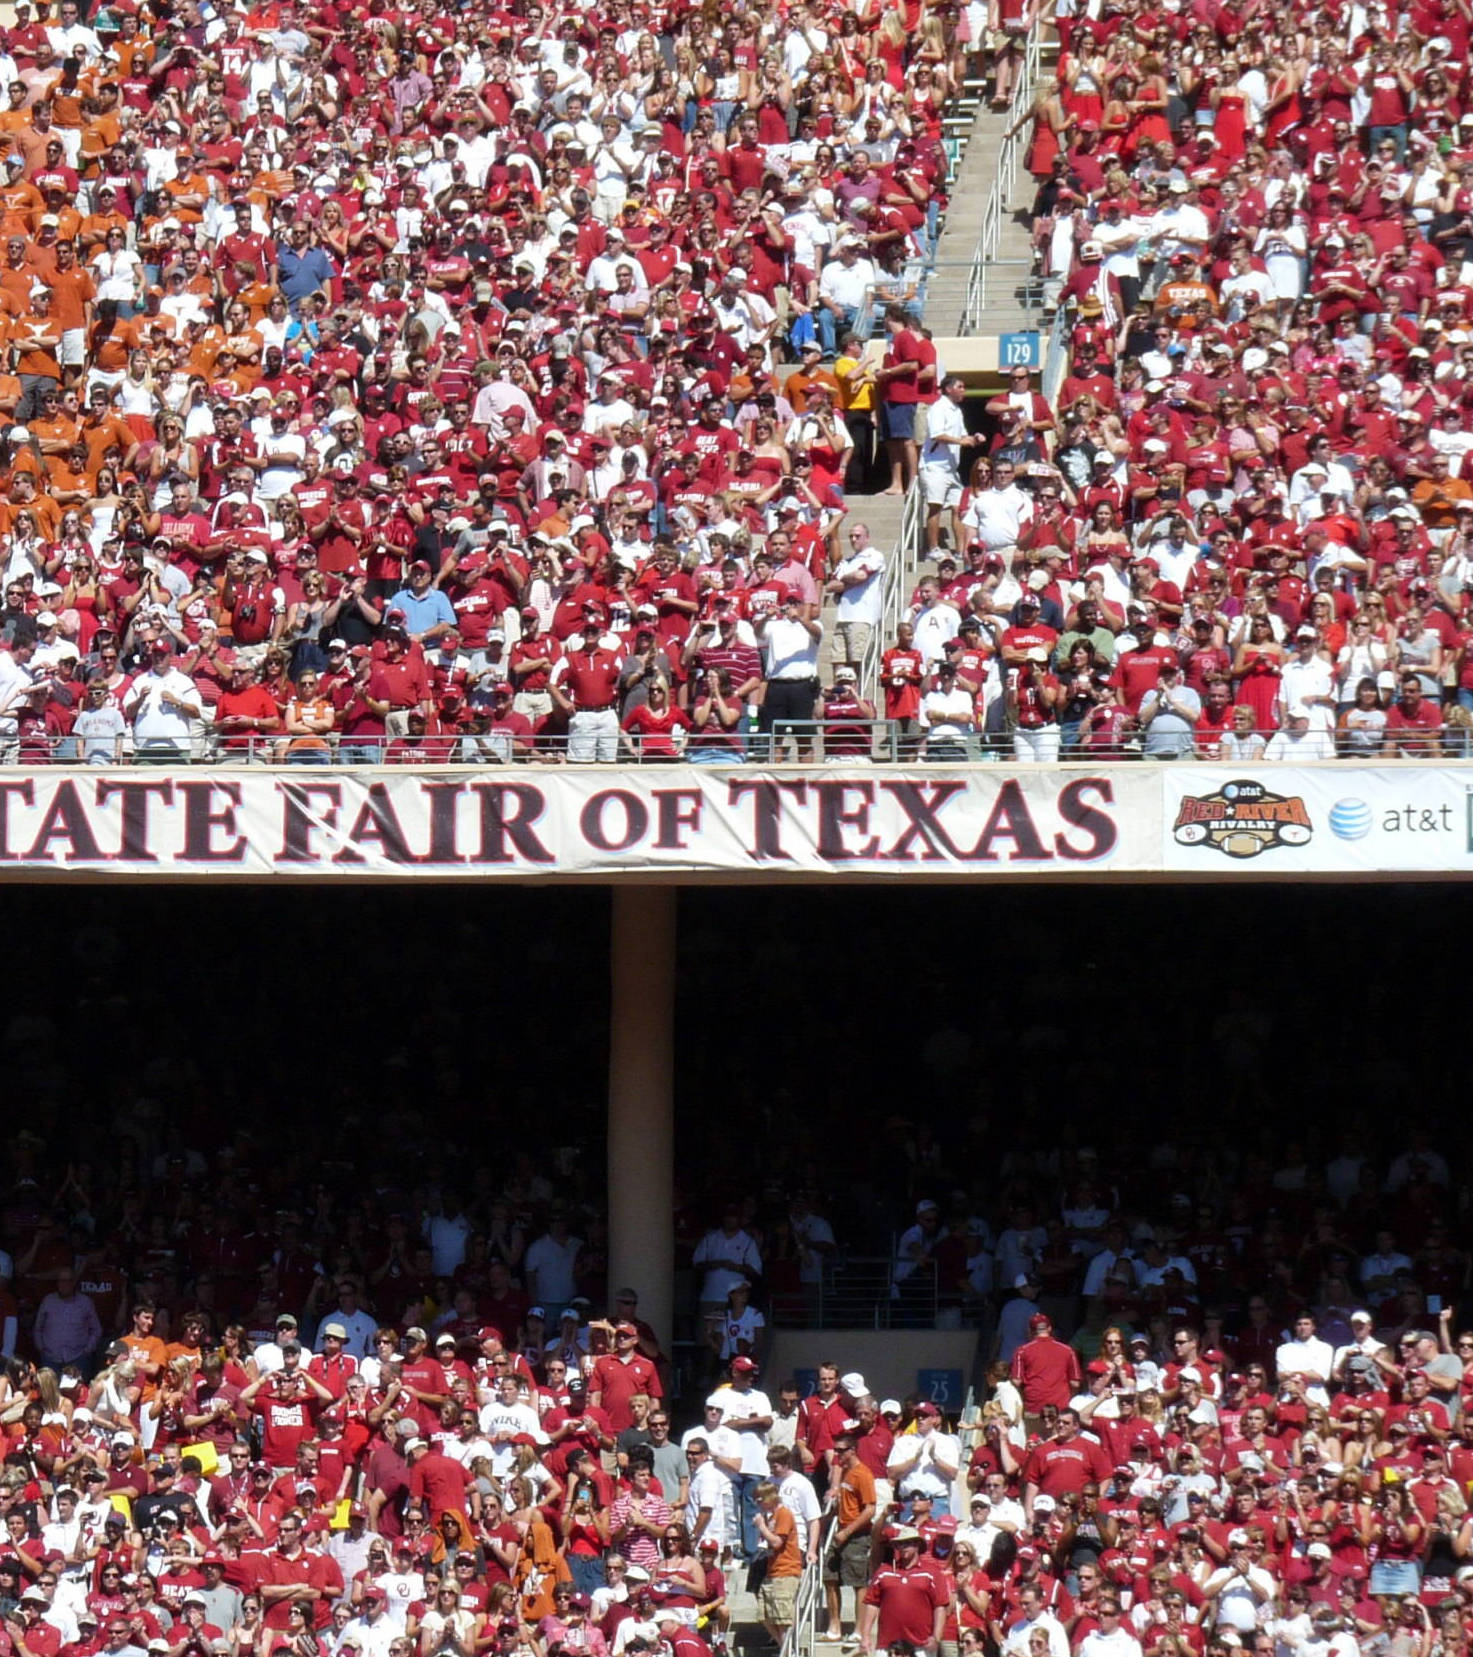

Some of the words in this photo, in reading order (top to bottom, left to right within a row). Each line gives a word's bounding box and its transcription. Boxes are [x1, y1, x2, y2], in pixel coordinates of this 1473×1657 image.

[222, 55, 243, 75] 14
[1167, 287, 1205, 299] TEXAS
[1007, 343, 1031, 364] 129
[162, 523, 195, 535] OKLAHOMA
[1176, 797, 1225, 826] RED
[1234, 797, 1311, 828] RIVER
[1382, 803, 1453, 832] at&t
[273, 780, 557, 864] FAIR
[579, 788, 704, 852] OF
[727, 777, 1119, 861] TEXAS
[1209, 820, 1276, 829] RIVALRY
[930, 1380, 949, 1402] 25
[271, 1404, 301, 1416] BOOMER
[271, 1416, 304, 1427] SOONER
[490, 1414, 522, 1430] NIKE
[161, 1585, 190, 1597] BEAT
[397, 1583, 410, 1598] OU
